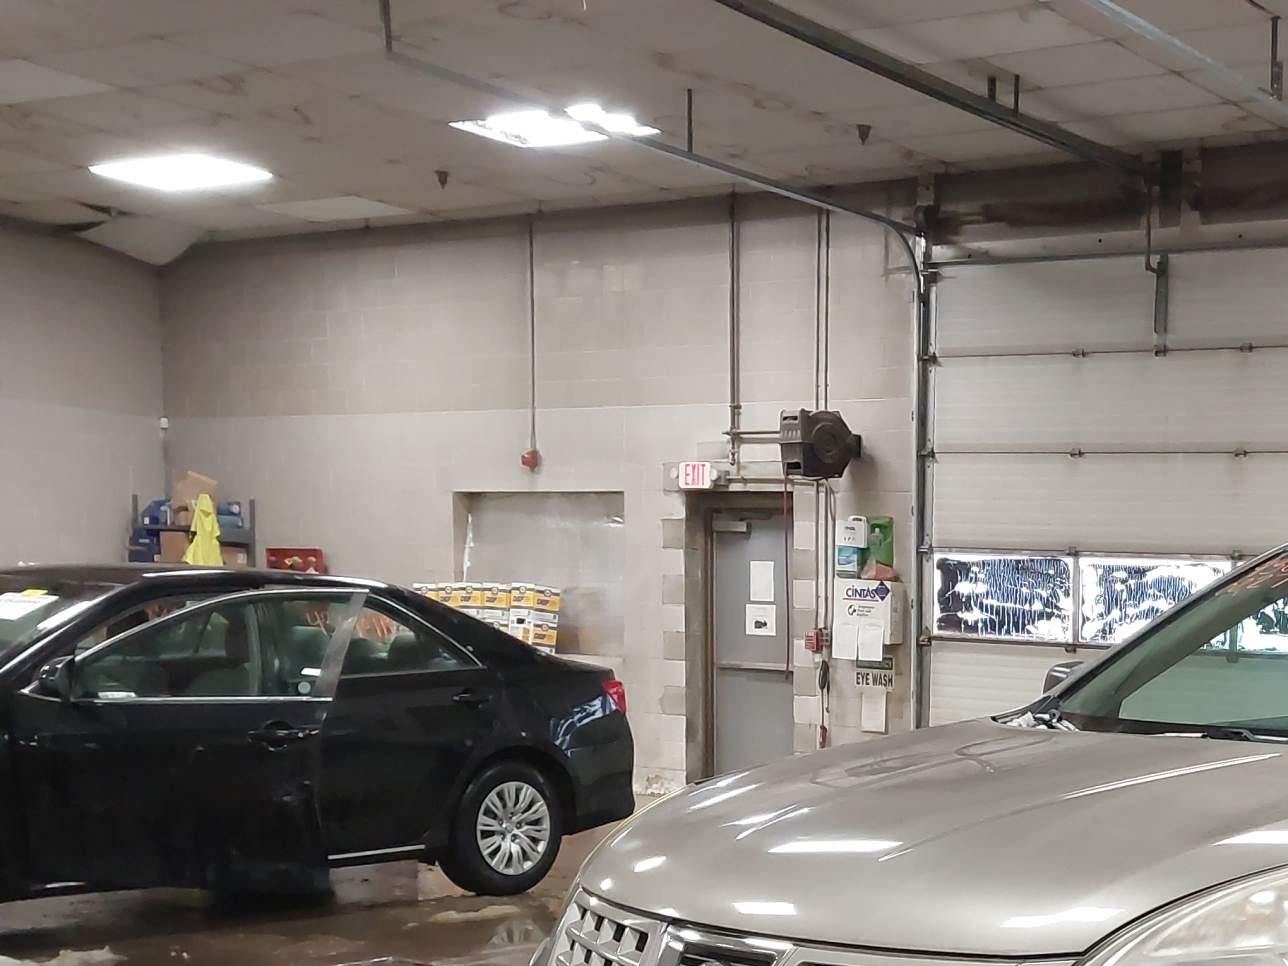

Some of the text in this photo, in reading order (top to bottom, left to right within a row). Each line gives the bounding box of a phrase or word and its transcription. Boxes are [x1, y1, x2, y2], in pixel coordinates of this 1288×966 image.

[684, 463, 706, 486] EXIT
[856, 671, 893, 688] EYE WASH
